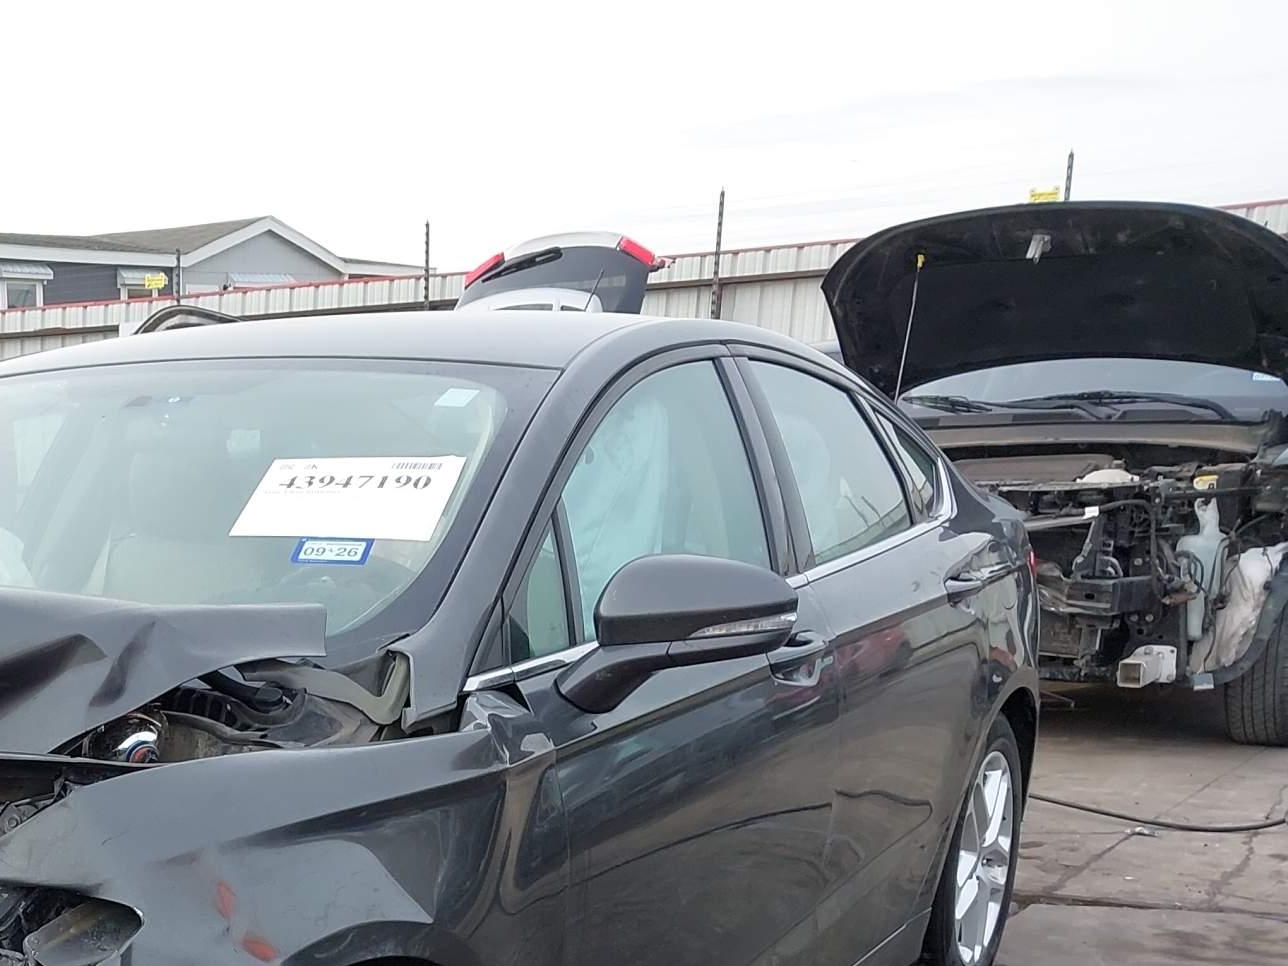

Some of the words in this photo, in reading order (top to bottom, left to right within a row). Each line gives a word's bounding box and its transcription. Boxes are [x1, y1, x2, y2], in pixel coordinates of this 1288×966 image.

[278, 474, 433, 491] 43947190
[303, 546, 326, 557] 09
[334, 547, 360, 558] 26
